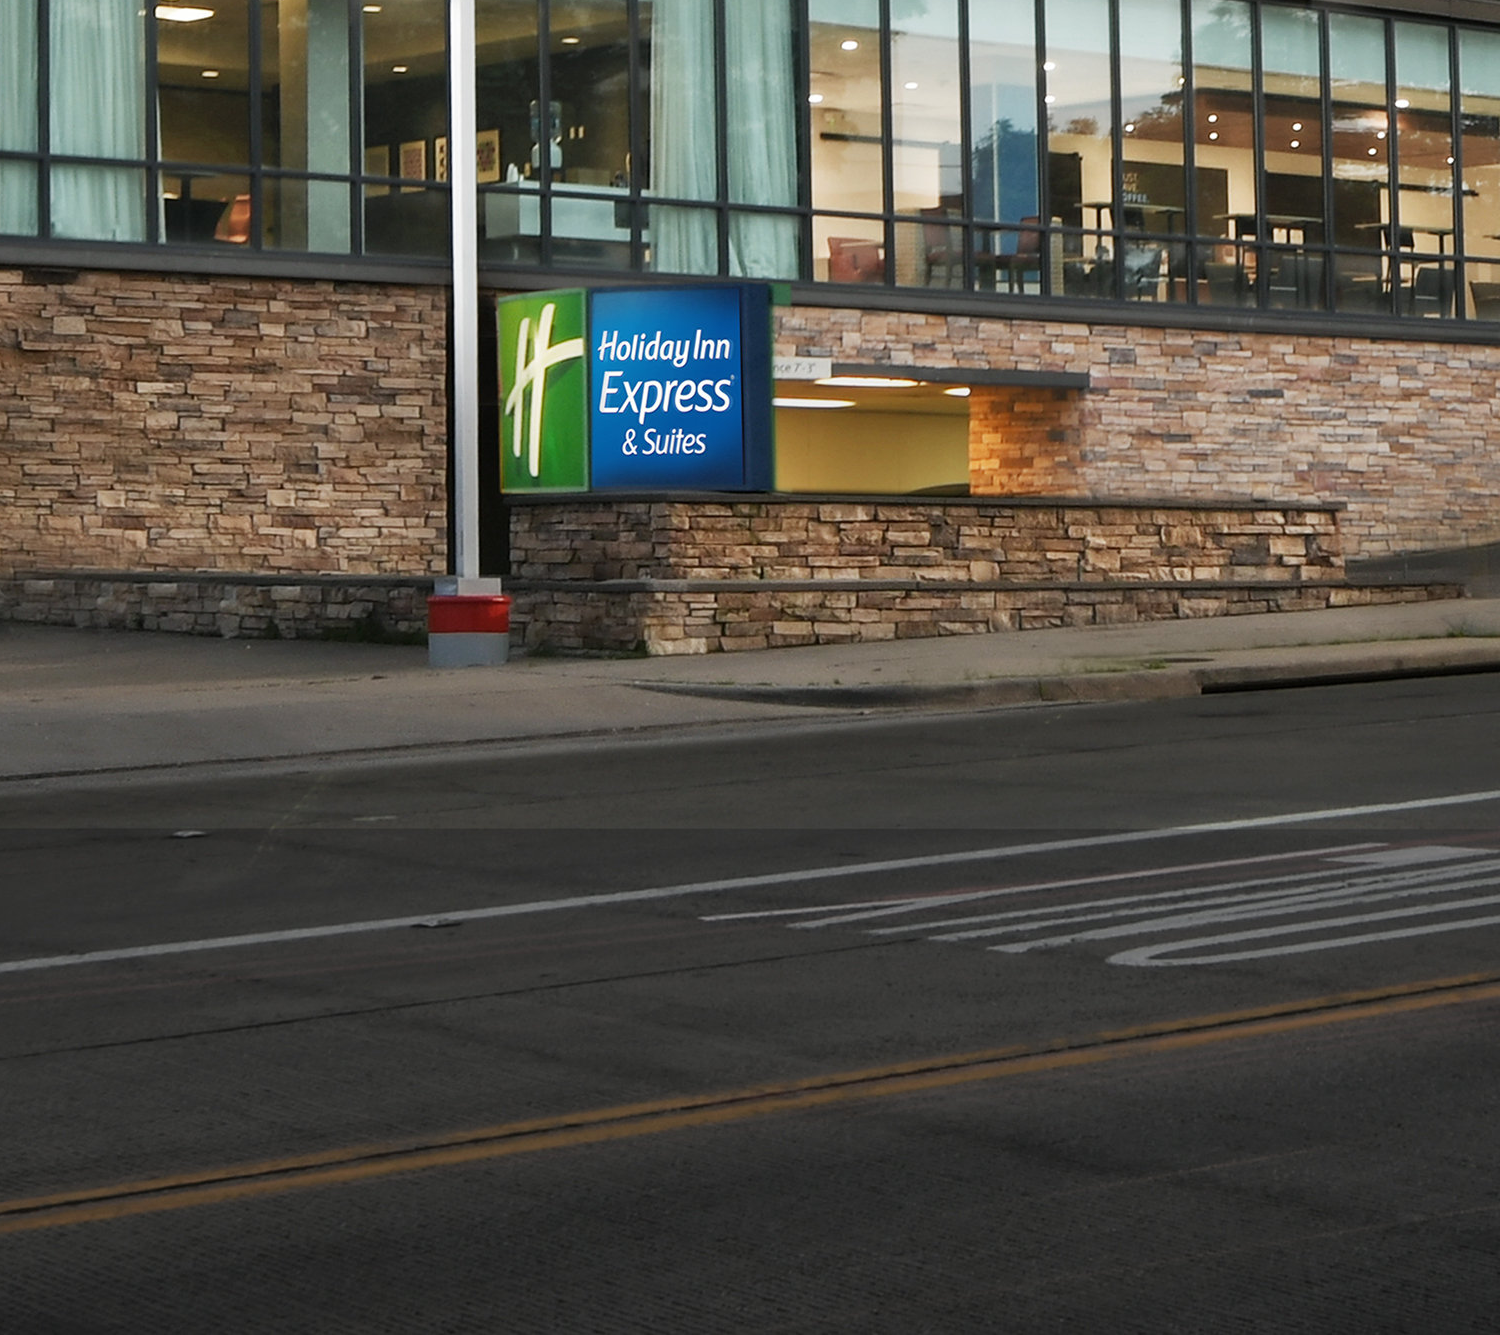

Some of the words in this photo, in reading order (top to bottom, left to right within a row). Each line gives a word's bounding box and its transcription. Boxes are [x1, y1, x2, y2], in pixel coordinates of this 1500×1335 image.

[597, 330, 691, 368] Holiday
[693, 329, 730, 360] Inn
[599, 370, 732, 425] Express
[622, 428, 638, 455] &
[642, 428, 707, 455] Suites
